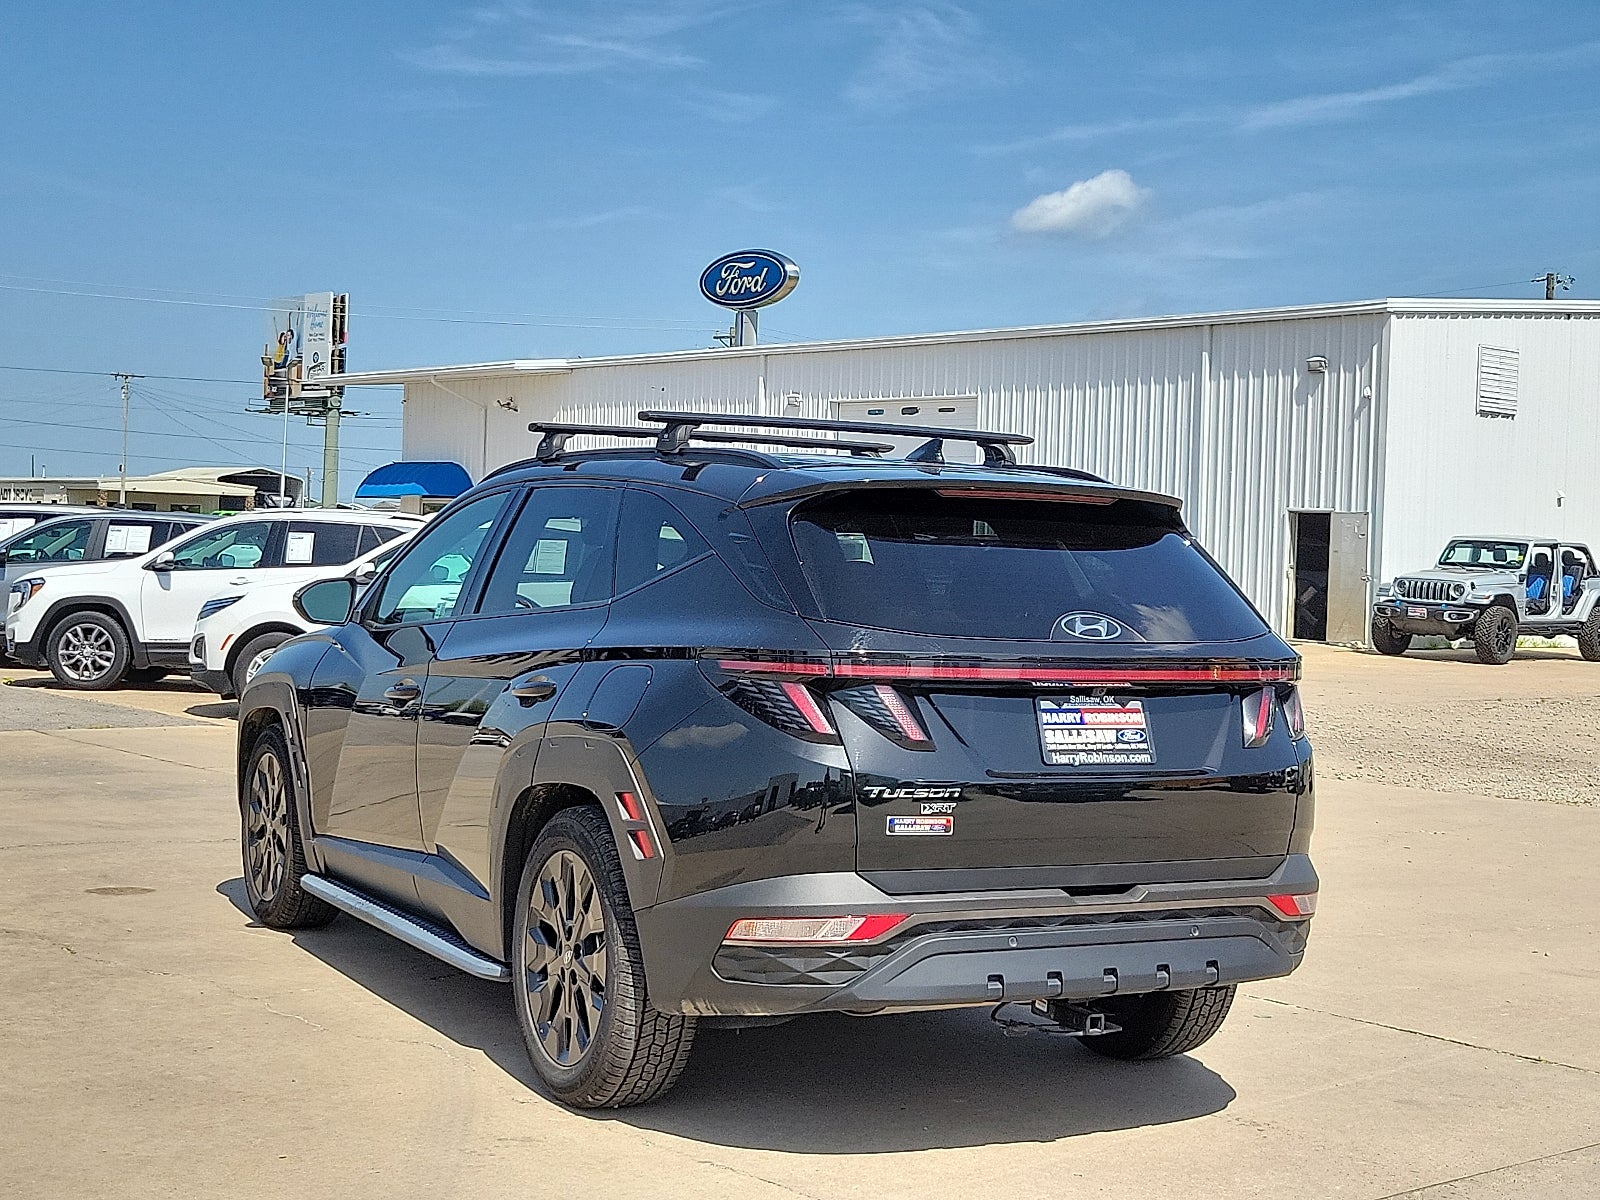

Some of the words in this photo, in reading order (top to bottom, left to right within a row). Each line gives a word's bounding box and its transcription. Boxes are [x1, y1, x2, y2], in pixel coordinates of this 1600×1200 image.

[716, 261, 768, 296] Ford
[1070, 695, 1102, 704] Sallisaw,
[1103, 695, 1115, 703] OK
[1041, 712, 1082, 724] HARRY
[1084, 712, 1144, 724] ROBINSON
[1044, 729, 1118, 743] SALLISAW
[1052, 752, 1151, 766] HarryRobinson.com
